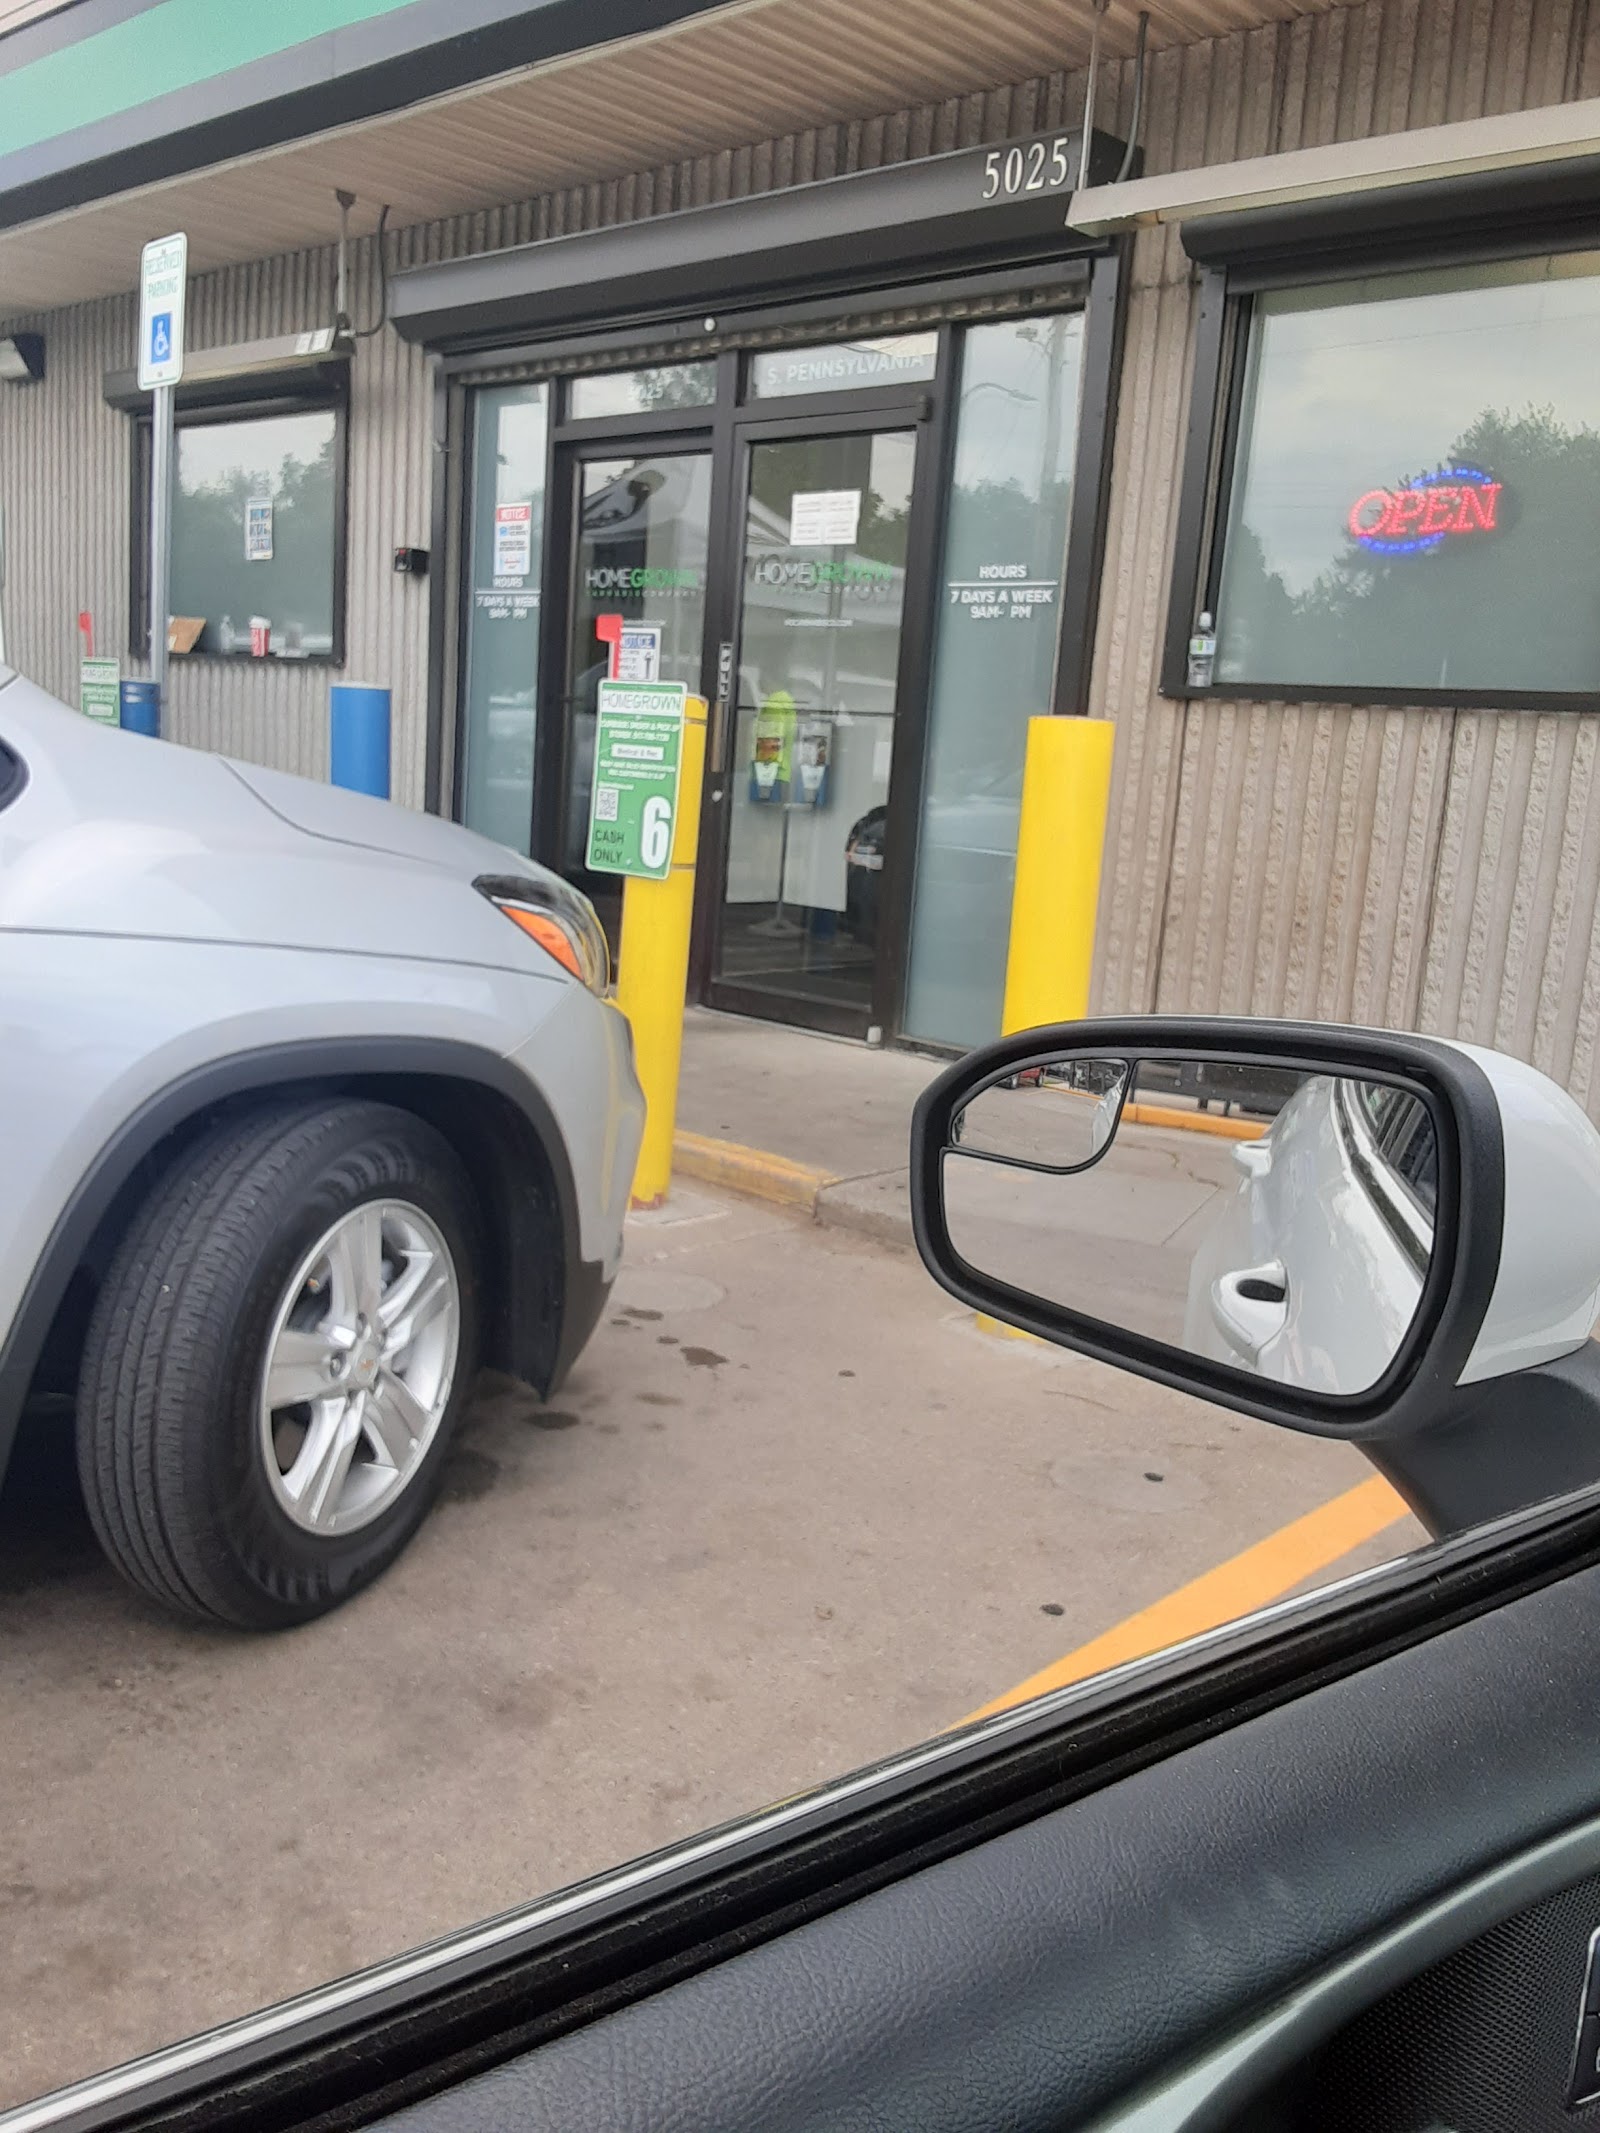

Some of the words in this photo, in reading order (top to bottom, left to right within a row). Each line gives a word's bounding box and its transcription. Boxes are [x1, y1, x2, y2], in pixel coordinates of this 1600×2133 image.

[982, 137, 1068, 199] 5025
[786, 352, 926, 384] PENNSYLVANIA
[1348, 482, 1504, 538] OPEN
[979, 565, 1028, 579] HOURS
[493, 576, 524, 588] HOURS
[483, 596, 505, 607] DAYS
[506, 596, 513, 607] A
[514, 596, 540, 607] WEEK
[950, 590, 960, 604] 7
[961, 590, 996, 604] DAYS
[997, 590, 1009, 603] A
[1011, 589, 1054, 603] WEEK
[1010, 604, 1032, 618] PM
[601, 692, 682, 712] HOMEGROWN
[594, 829, 625, 844] CASH
[641, 795, 672, 869] 6
[593, 848, 623, 863] ONLY
